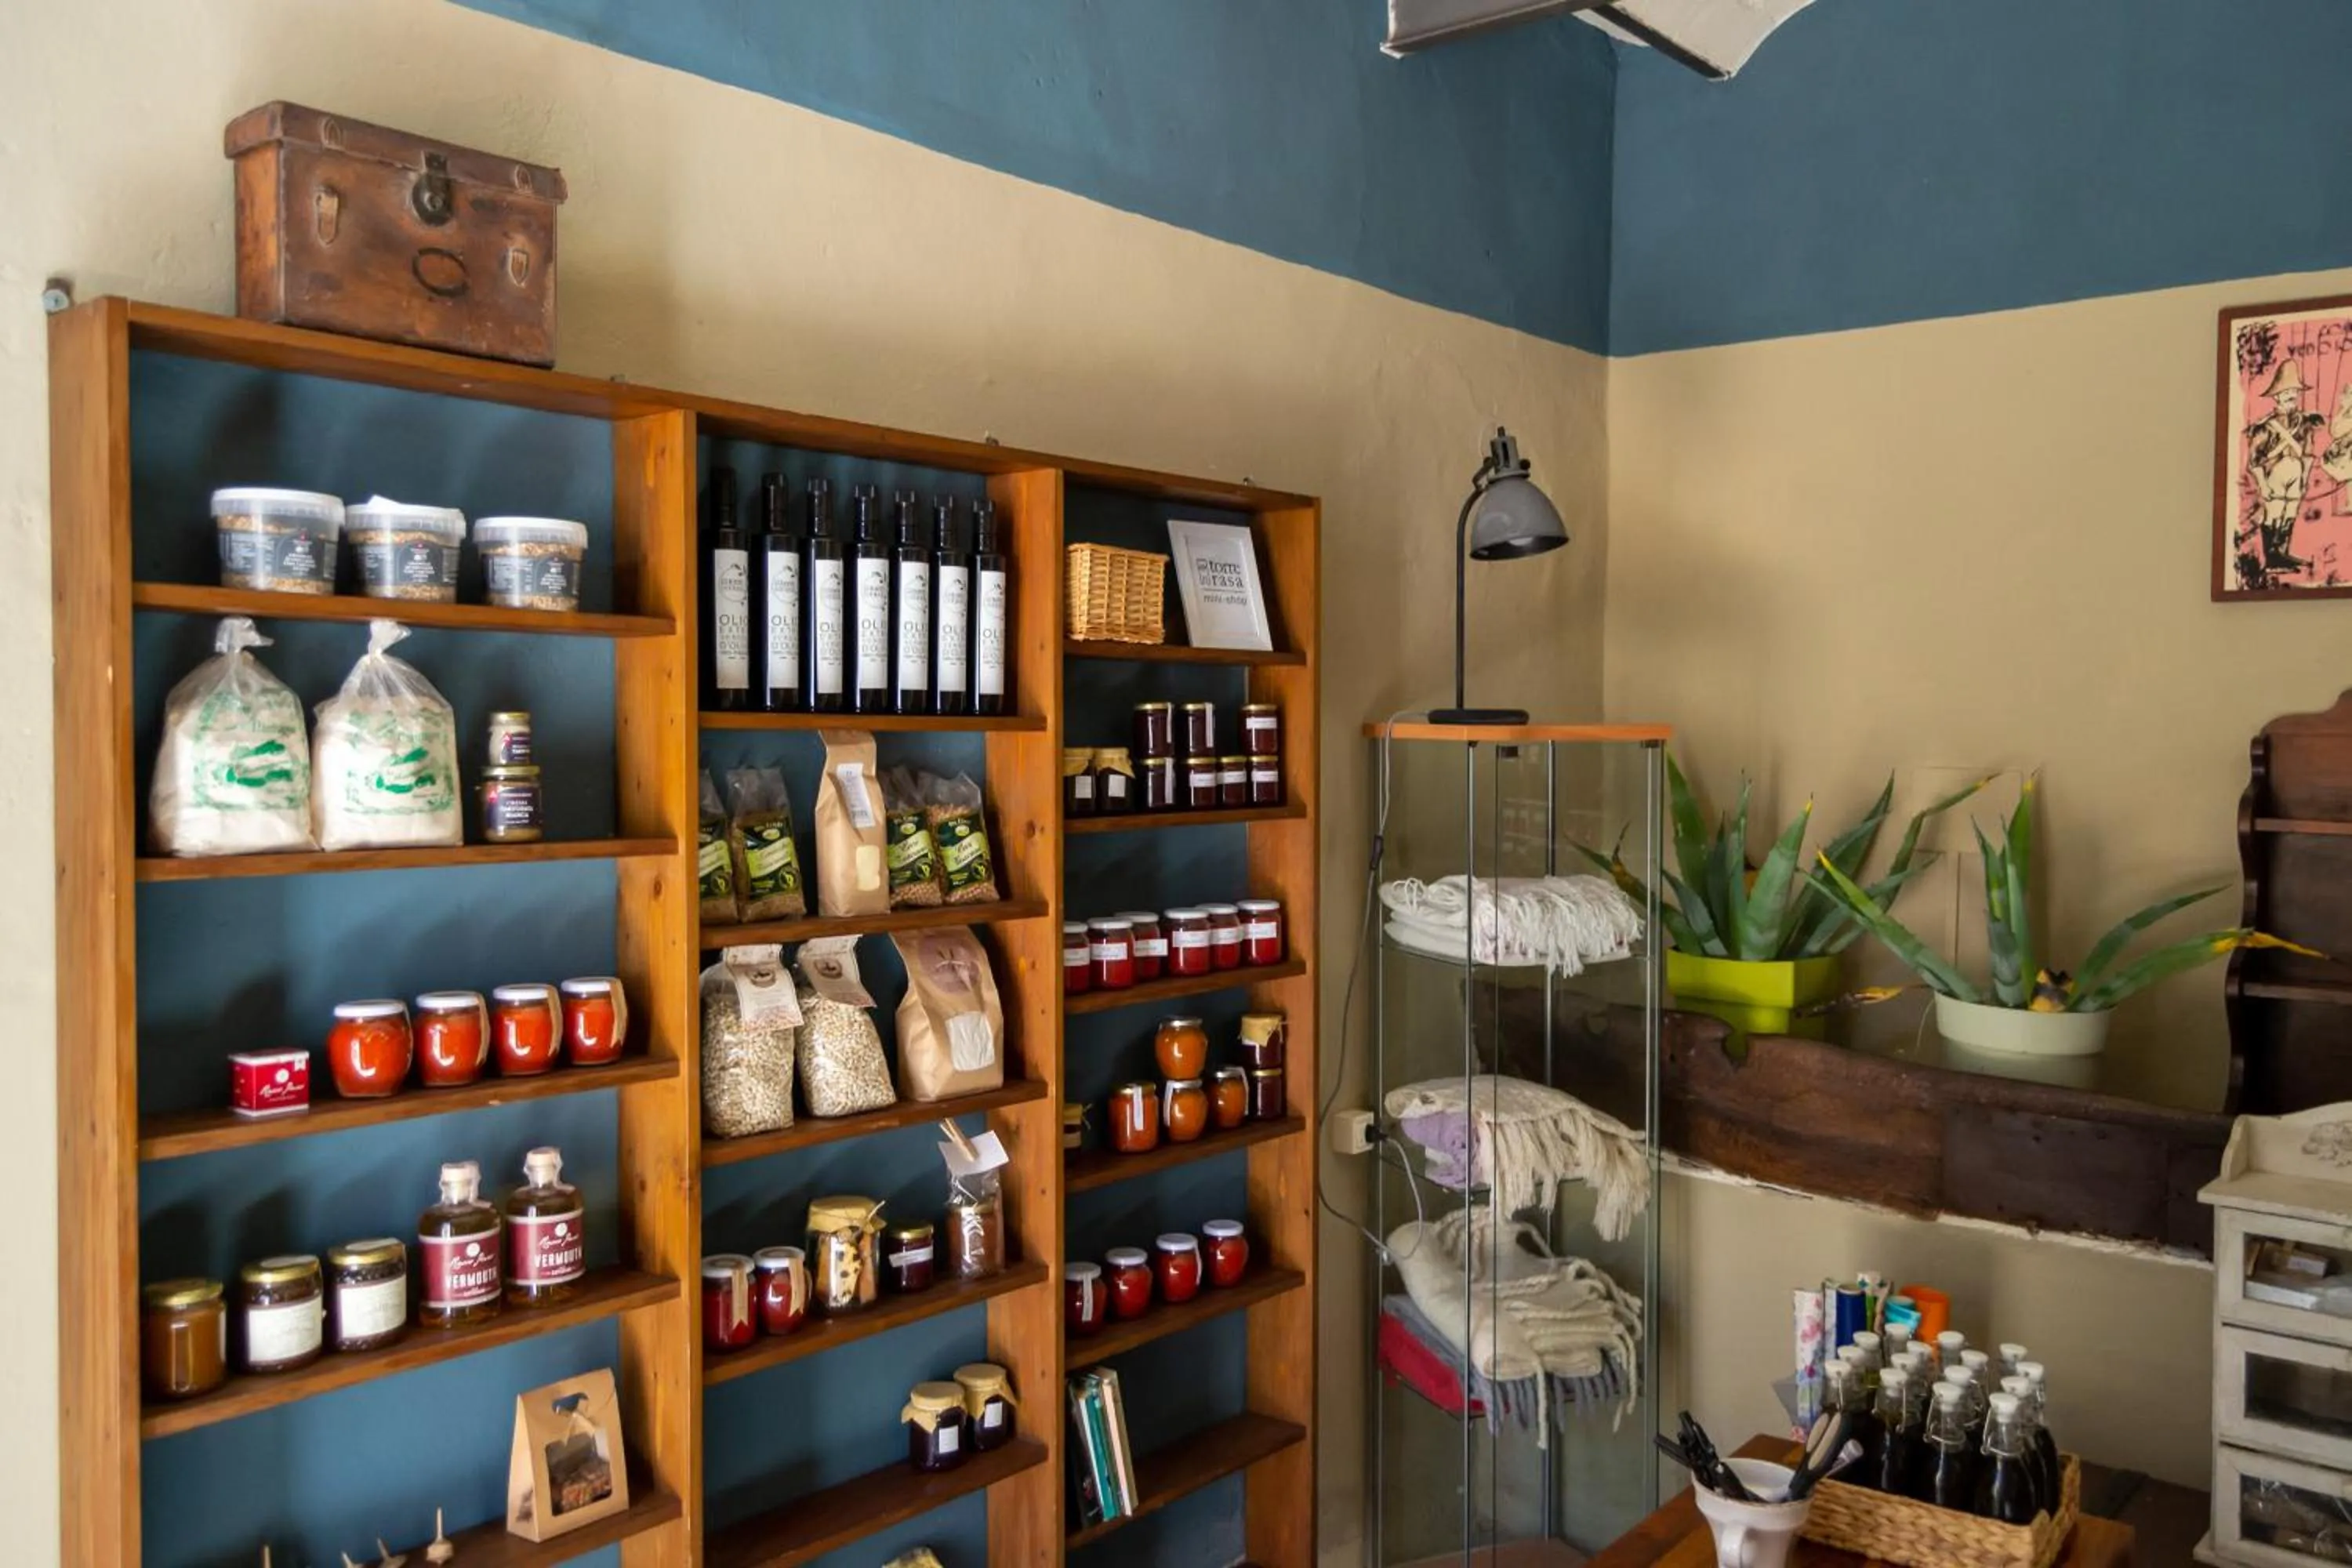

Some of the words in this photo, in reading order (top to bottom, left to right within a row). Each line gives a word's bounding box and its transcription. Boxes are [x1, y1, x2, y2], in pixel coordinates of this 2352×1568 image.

[1211, 575, 1244, 589] rasa
[534, 1246, 583, 1268] VERMOUTH
[445, 1266, 497, 1290] VERMOUTH
